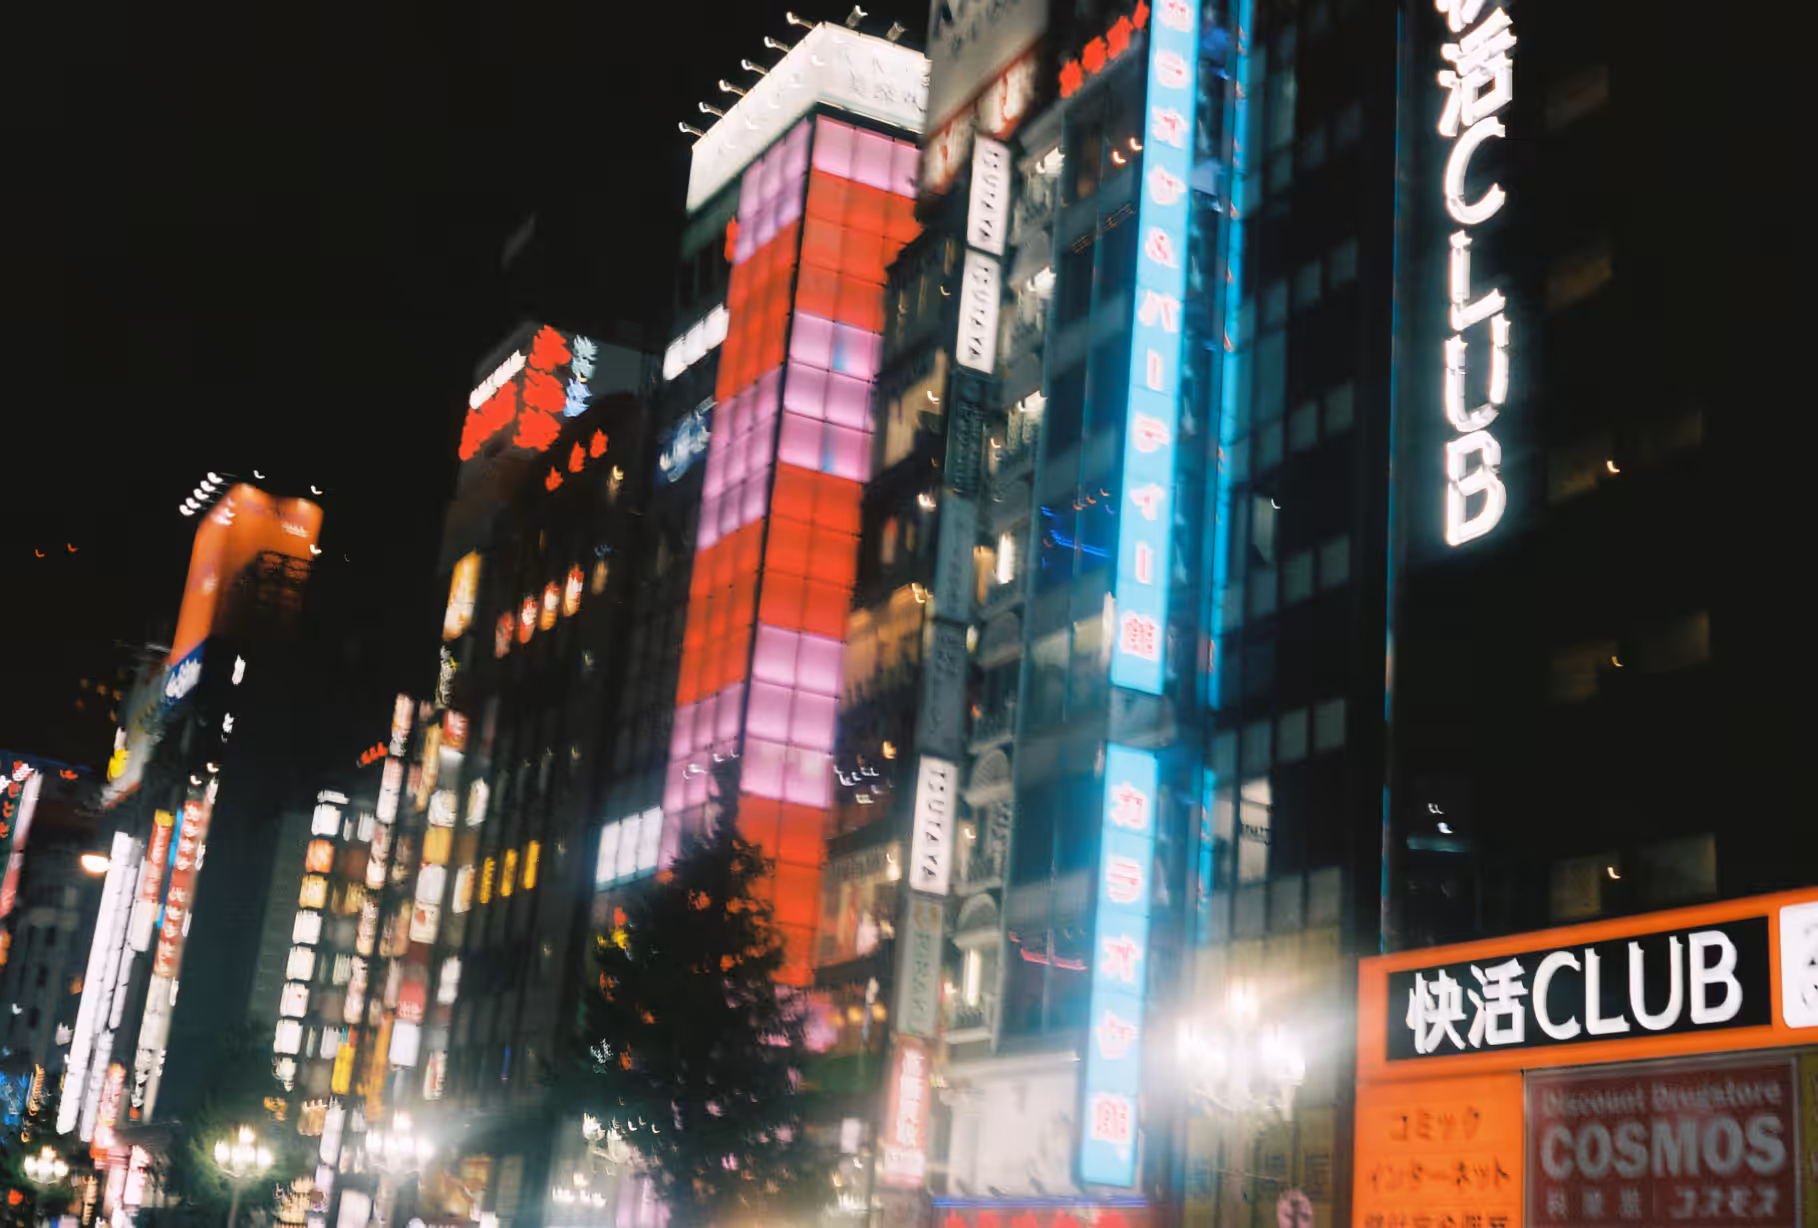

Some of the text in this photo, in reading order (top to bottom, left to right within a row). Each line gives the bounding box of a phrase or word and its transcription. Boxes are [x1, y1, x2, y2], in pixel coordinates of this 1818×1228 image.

[921, 767, 946, 880] TSUTAYA
[1406, 929, 1743, 1055] 快活CLUB
[1542, 1077, 1782, 1118] Discount Drugstore
[1540, 1113, 1786, 1180] COSMOS
[1670, 1183, 1779, 1220] コスモス
